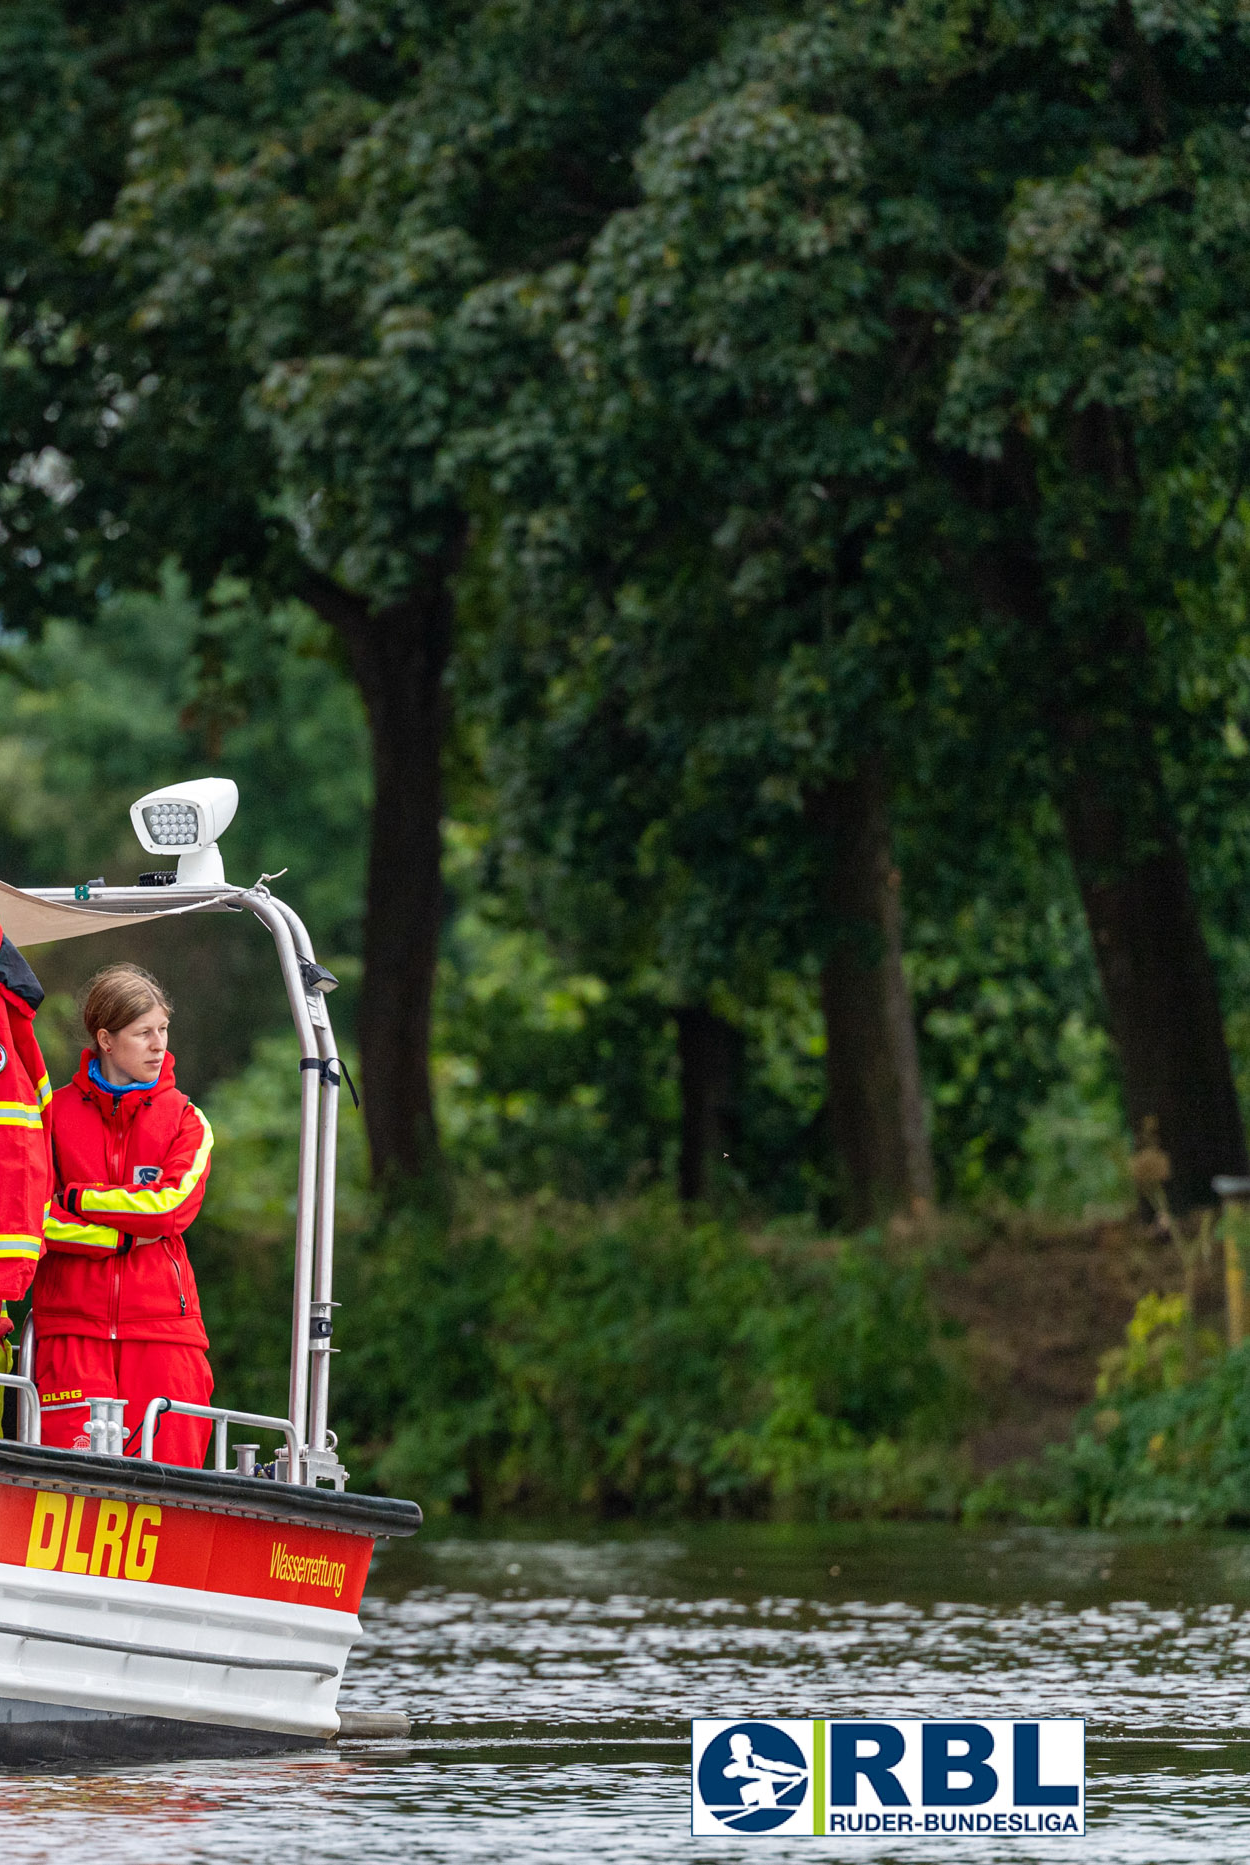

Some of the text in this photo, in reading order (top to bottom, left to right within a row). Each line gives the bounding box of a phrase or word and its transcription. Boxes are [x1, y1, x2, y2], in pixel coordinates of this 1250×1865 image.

[42, 1389, 82, 1403] DLRG
[25, 1491, 162, 1582] DLRG
[269, 1541, 347, 1599] Wasserrettung
